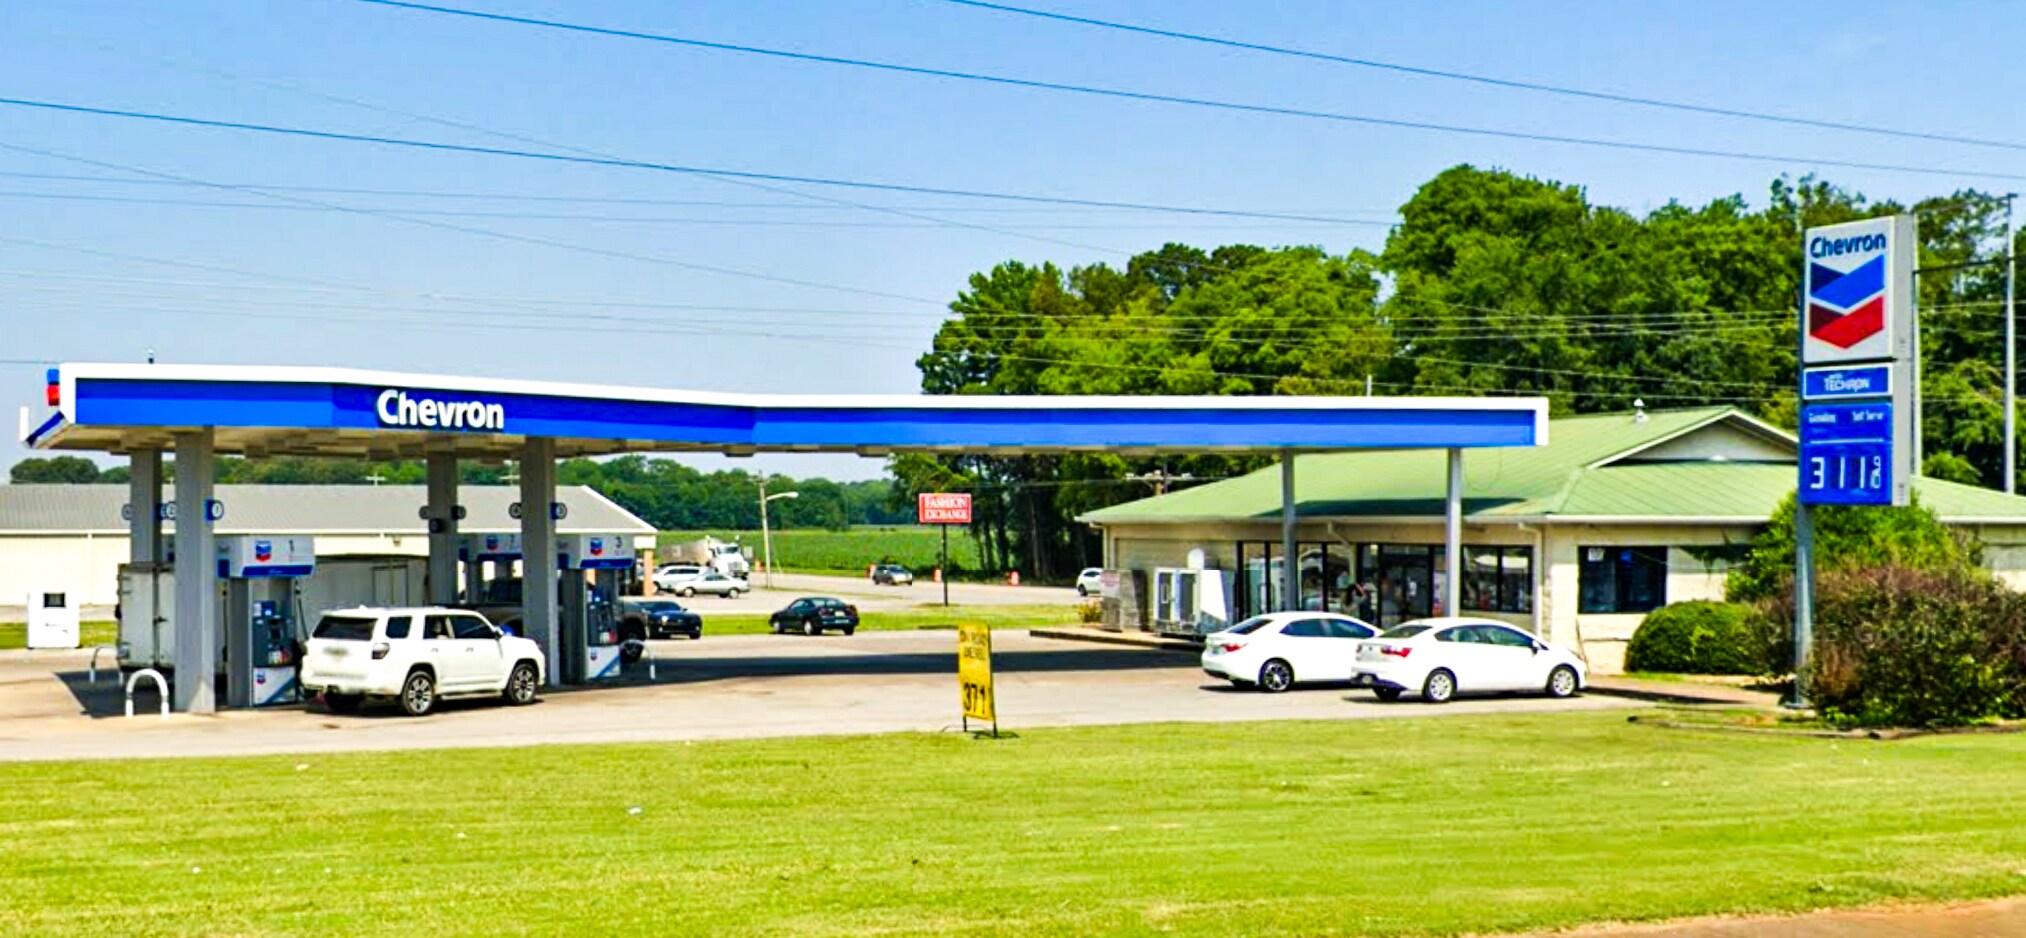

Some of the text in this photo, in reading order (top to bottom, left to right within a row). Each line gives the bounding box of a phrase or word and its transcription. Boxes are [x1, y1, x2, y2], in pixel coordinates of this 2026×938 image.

[1810, 233, 1886, 258] Chevron
[377, 388, 504, 429] Chevron
[925, 496, 968, 508] FASHION
[964, 682, 986, 715] 371
